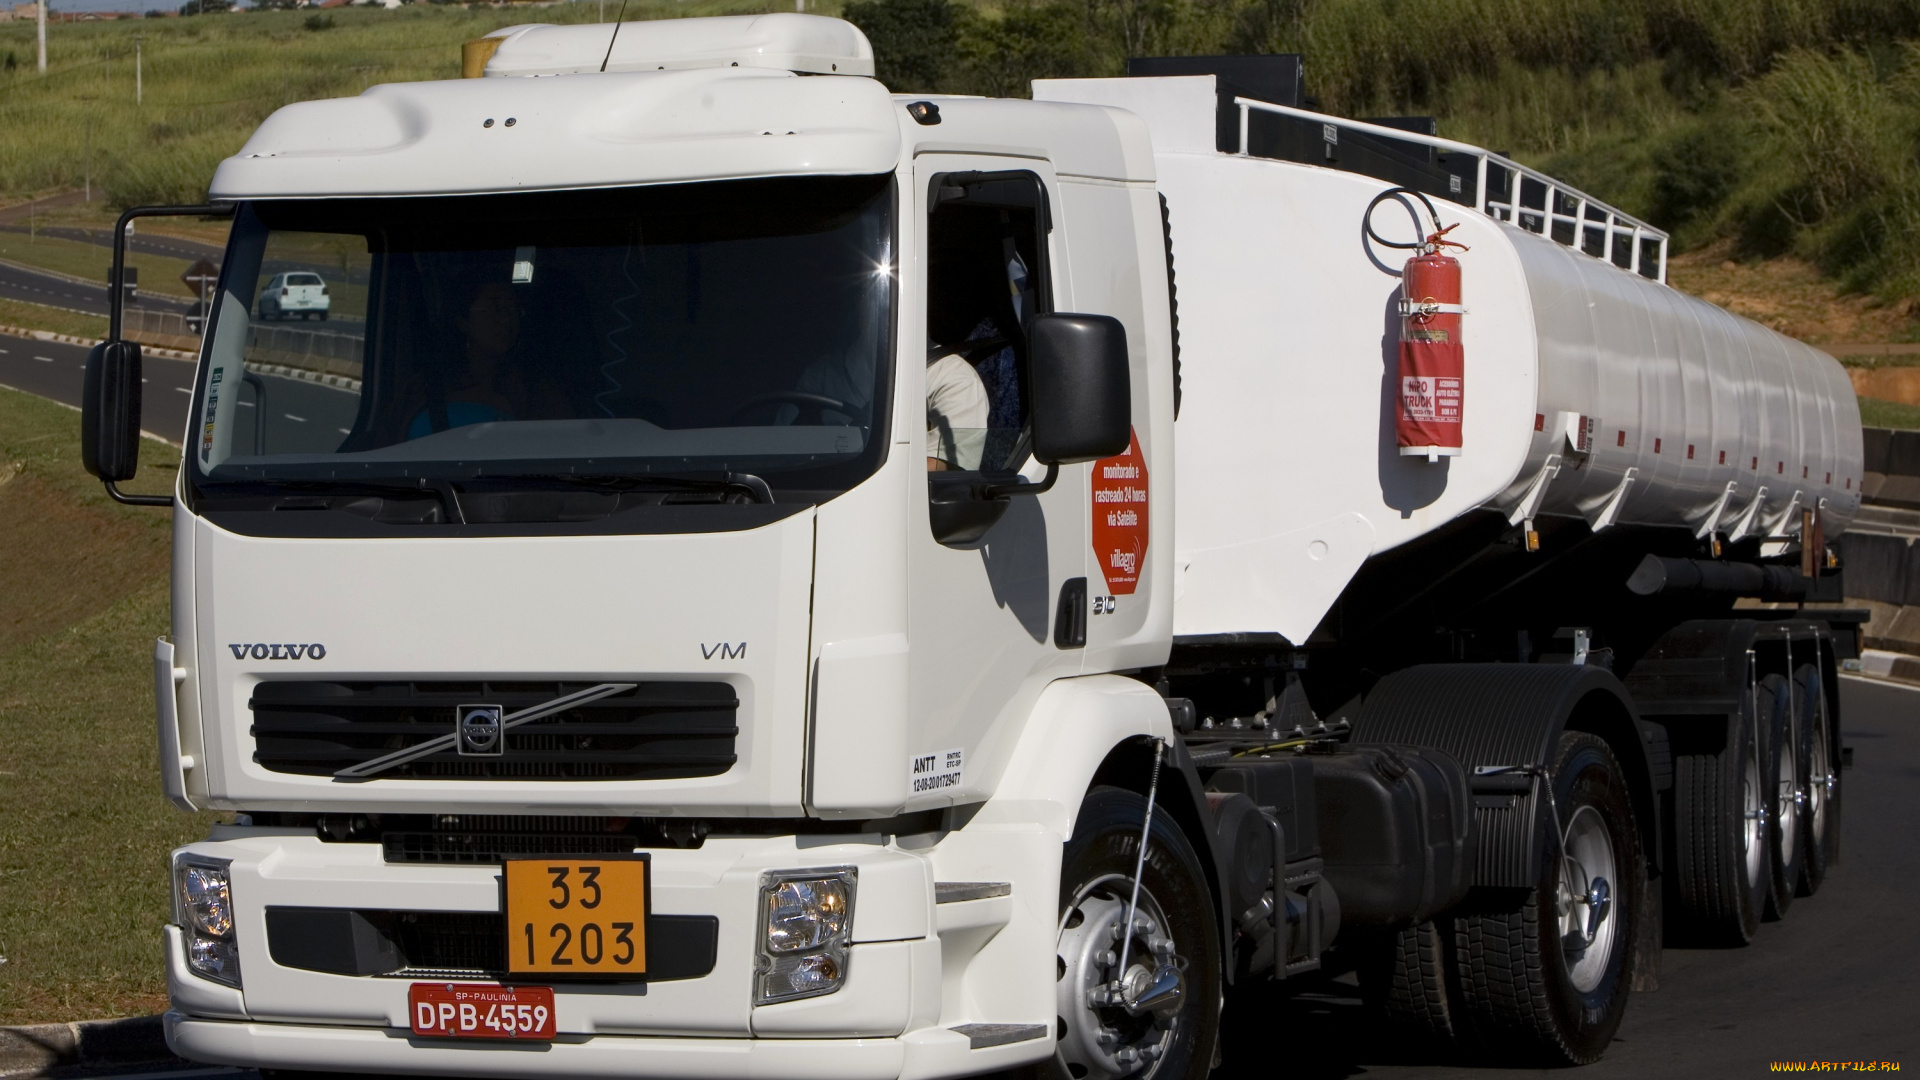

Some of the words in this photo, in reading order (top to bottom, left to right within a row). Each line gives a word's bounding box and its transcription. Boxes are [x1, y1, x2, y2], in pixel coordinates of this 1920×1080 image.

[1404, 396, 1432, 408] TRUCK
[1103, 462, 1135, 479] monitorado
[1135, 466, 1139, 479] e
[1095, 487, 1124, 503] rastreado
[1124, 486, 1132, 502] 24
[1132, 486, 1146, 502] horas
[1107, 510, 1117, 526] via
[1117, 509, 1138, 526] Satélite
[1110, 548, 1135, 572] villagro
[1093, 596, 1115, 615] 310
[228, 643, 327, 660] VOLVO
[700, 642, 747, 660] VM
[913, 755, 936, 774] ANTT
[947, 760, 961, 768] ETC-SP
[547, 866, 602, 910] 33
[524, 922, 635, 966] 1203
